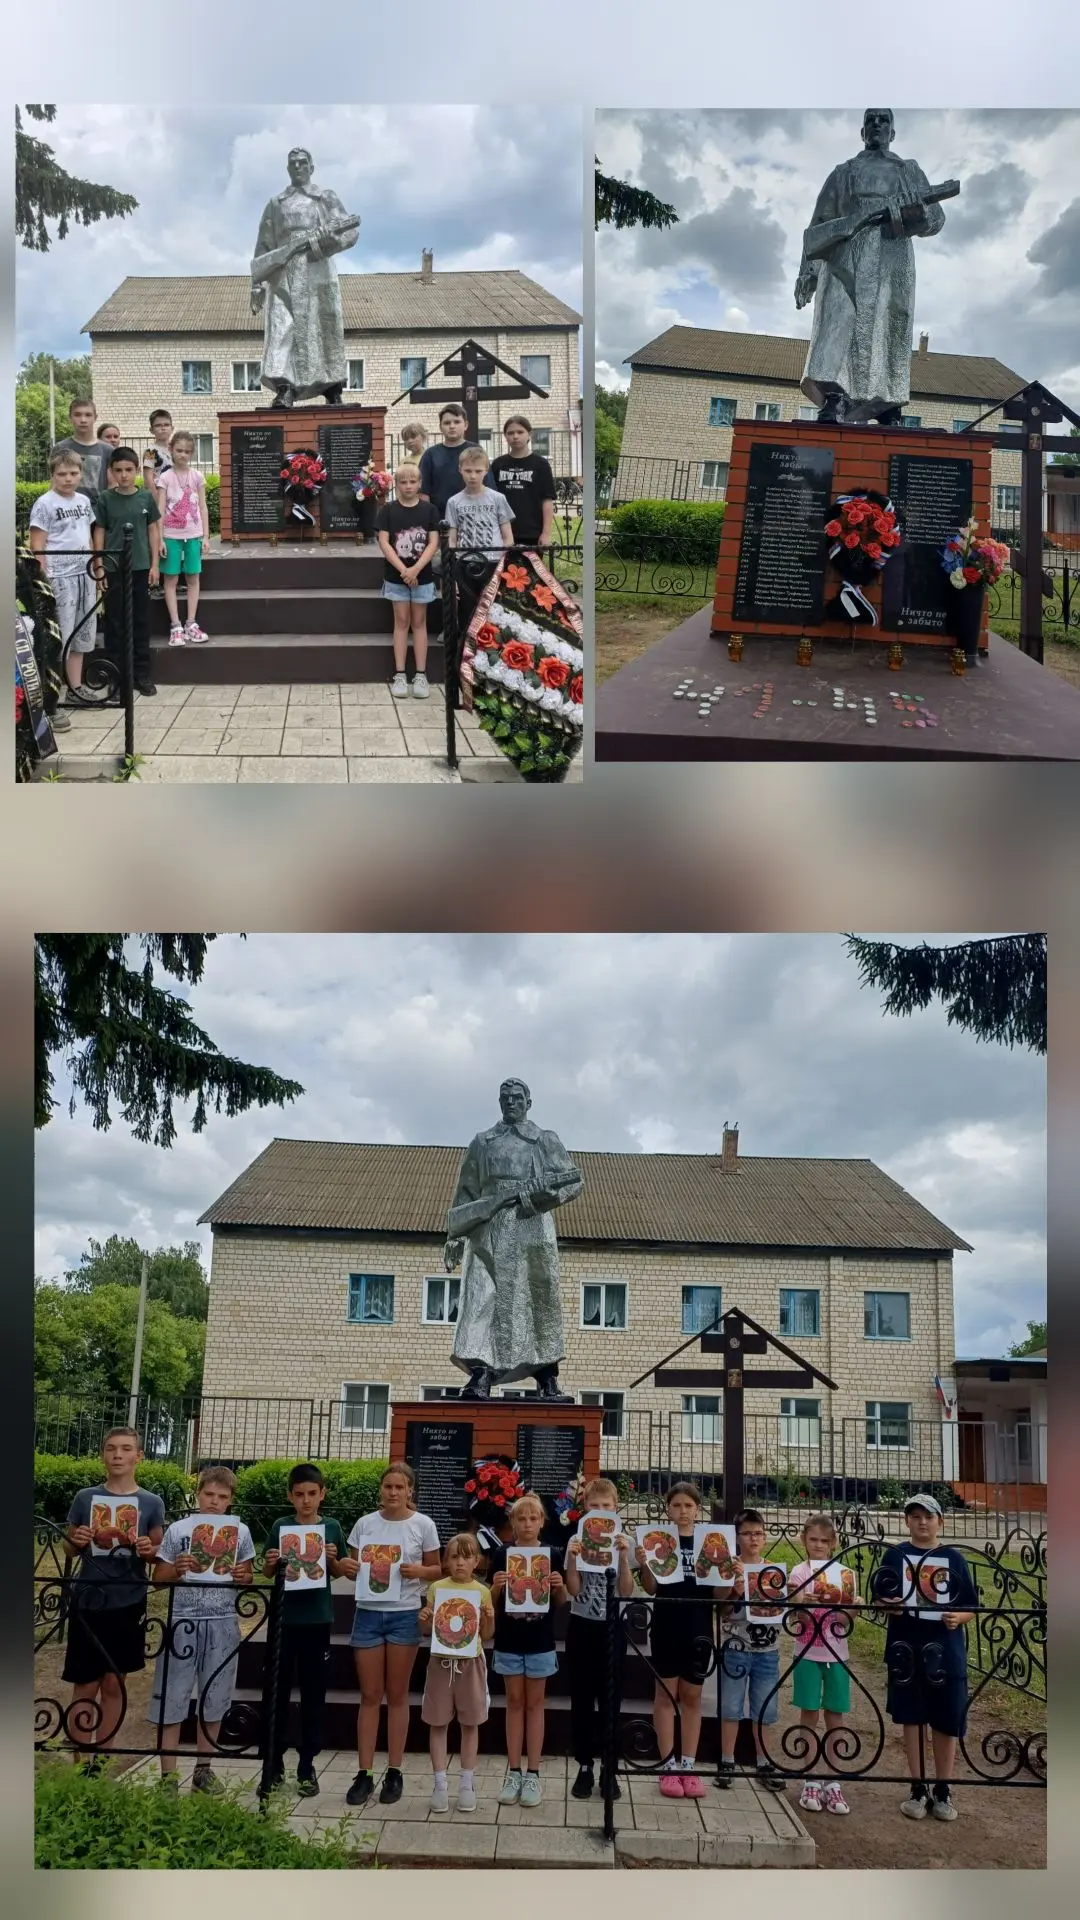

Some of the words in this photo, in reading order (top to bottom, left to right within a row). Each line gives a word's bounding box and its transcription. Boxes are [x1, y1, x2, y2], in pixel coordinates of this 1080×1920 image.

[499, 470, 515, 482] NEW
[516, 470, 534, 483] YORK
[901, 607, 933, 617] Ничто
[907, 617, 943, 627] забыто
